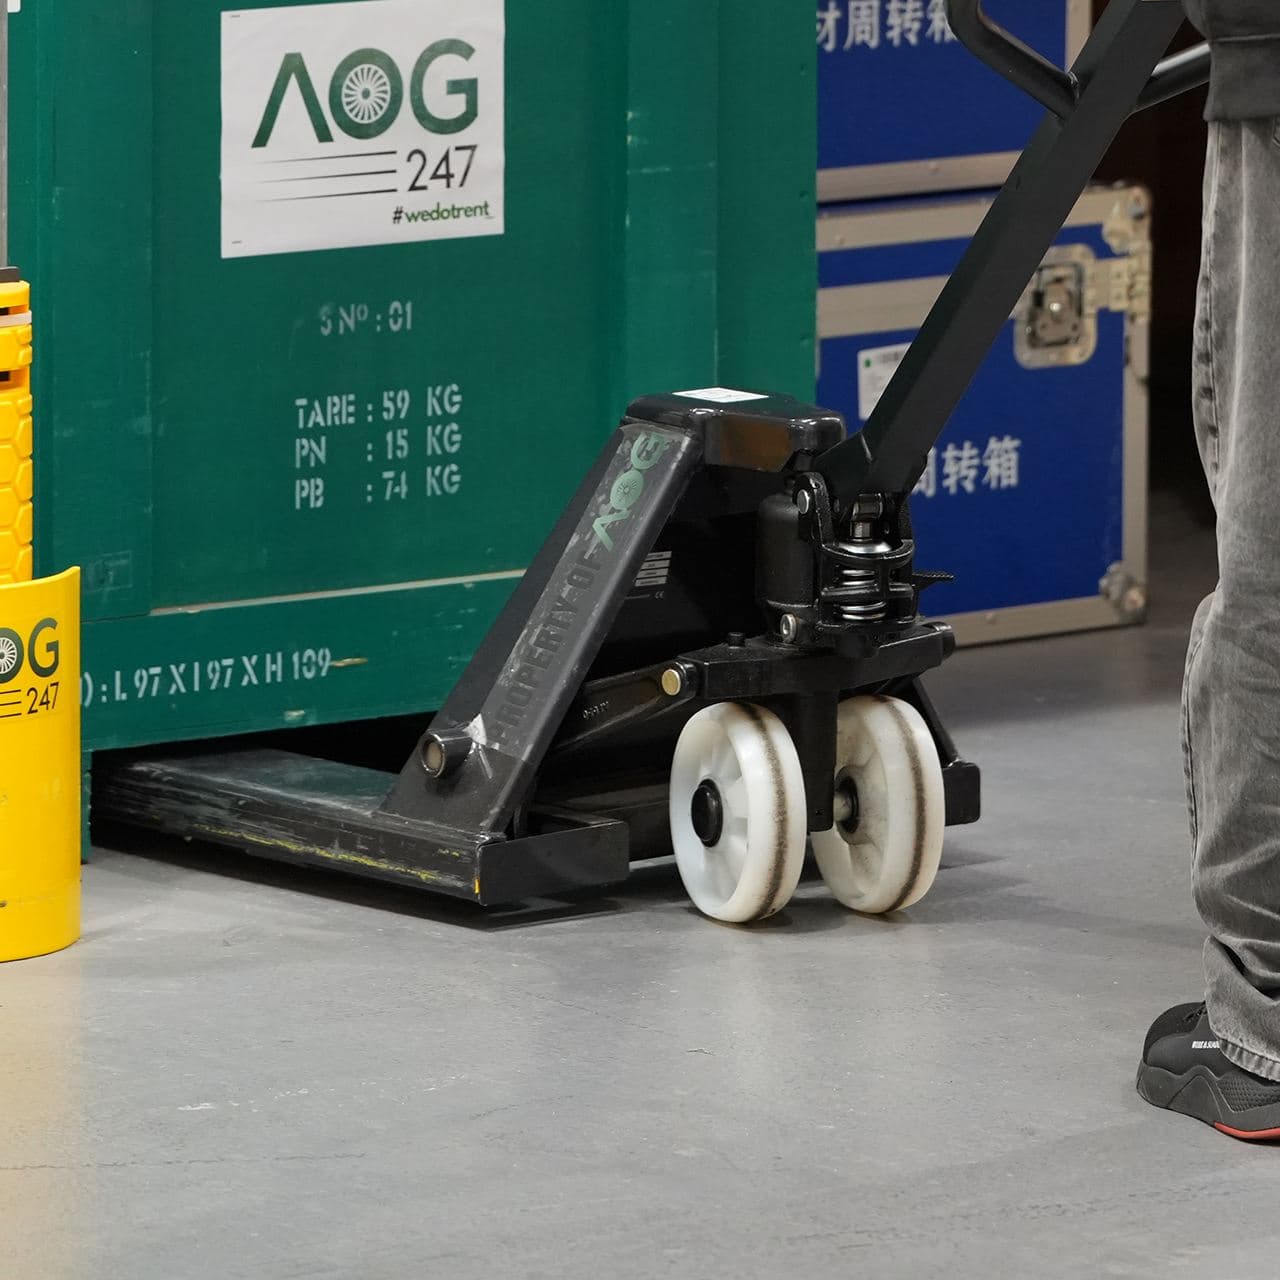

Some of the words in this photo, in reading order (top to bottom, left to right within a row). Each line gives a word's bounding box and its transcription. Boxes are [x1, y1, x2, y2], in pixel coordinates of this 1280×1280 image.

[251, 38, 478, 149] AOG
[406, 145, 478, 192] 247
[393, 200, 490, 225] #wedotrent
[389, 301, 413, 332] 01
[295, 394, 355, 429] TARE
[382, 389, 411, 420] 59
[426, 383, 462, 417] KG
[295, 435, 327, 469] PN
[386, 428, 409, 460] 15
[426, 422, 462, 456] KG
[295, 477, 325, 510] PB
[382, 470, 408, 501] 74
[426, 463, 462, 497] KG
[293, 648, 331, 680] 109
[27, 682, 59, 714] 247
